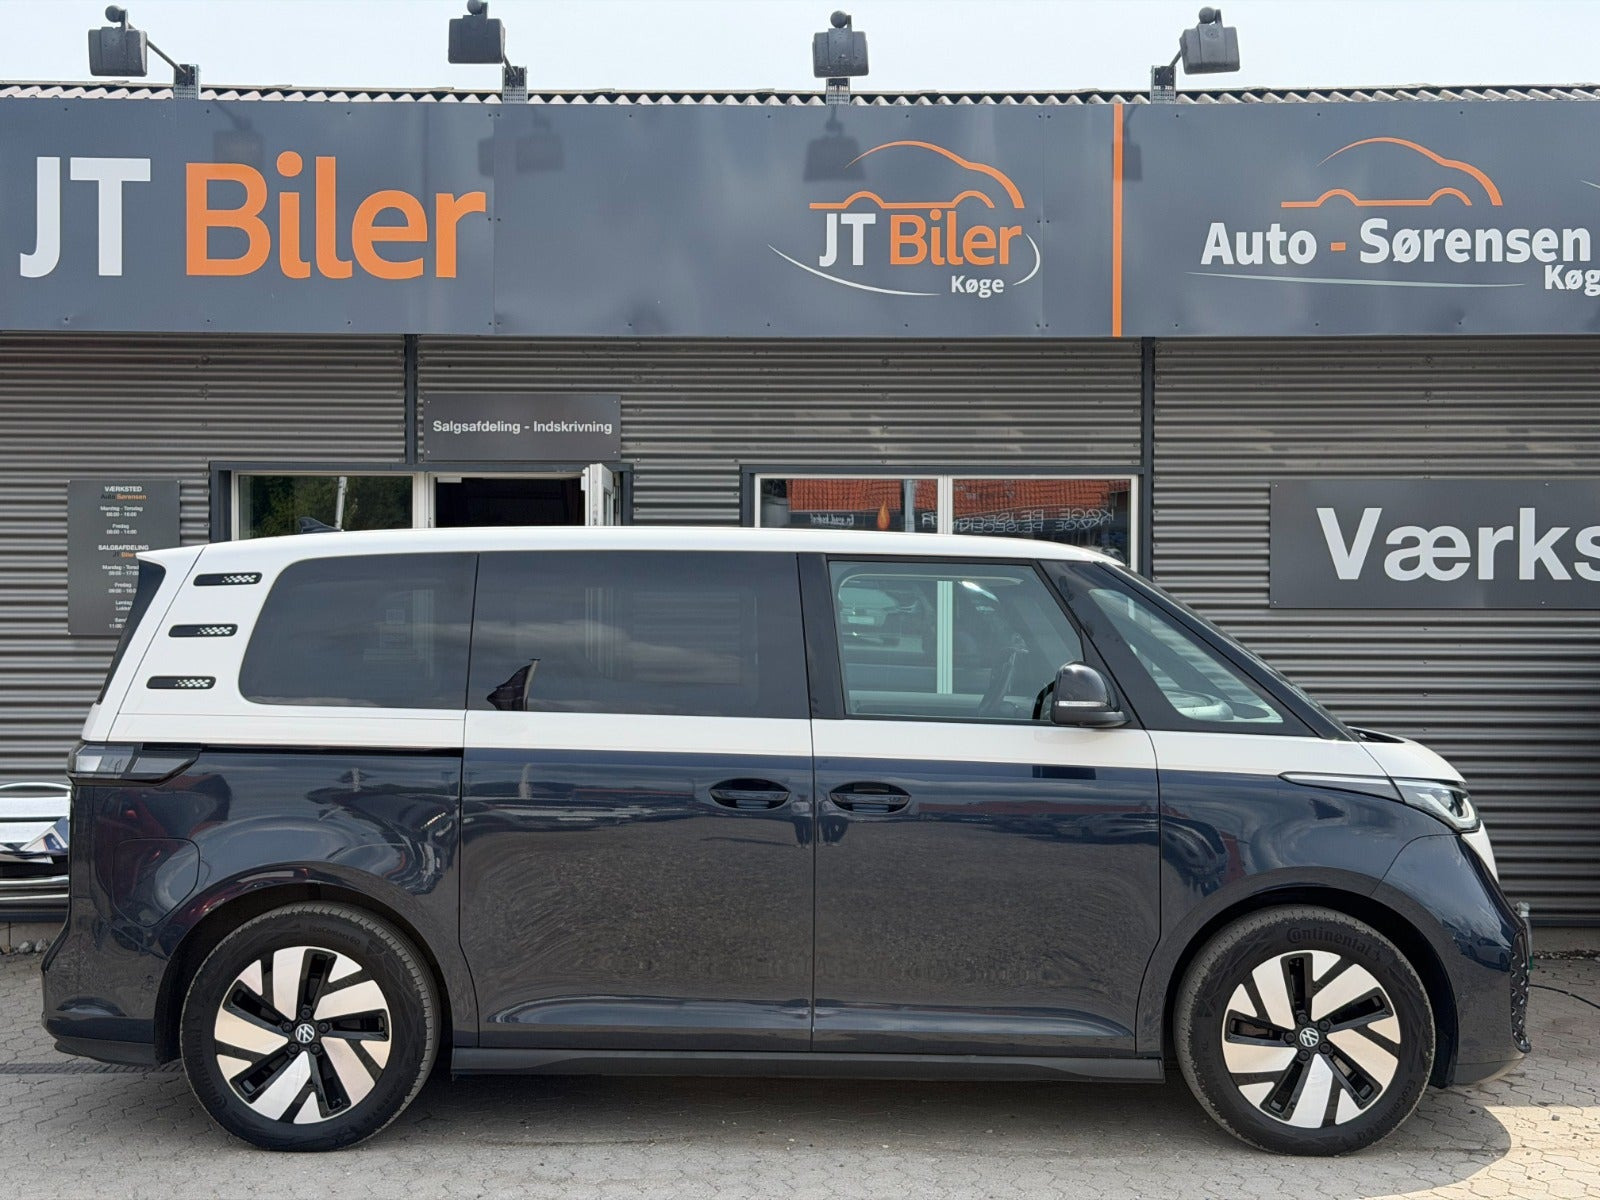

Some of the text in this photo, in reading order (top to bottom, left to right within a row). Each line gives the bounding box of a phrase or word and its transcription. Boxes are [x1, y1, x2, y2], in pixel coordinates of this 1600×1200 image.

[20, 151, 486, 279] JT Biler
[819, 208, 1022, 267] JT Biler
[1201, 218, 1591, 265] Auto - Sørensen
[951, 275, 1004, 298] Køge
[433, 420, 521, 434] Salgsafdeling
[533, 421, 613, 434] Indskrivning
